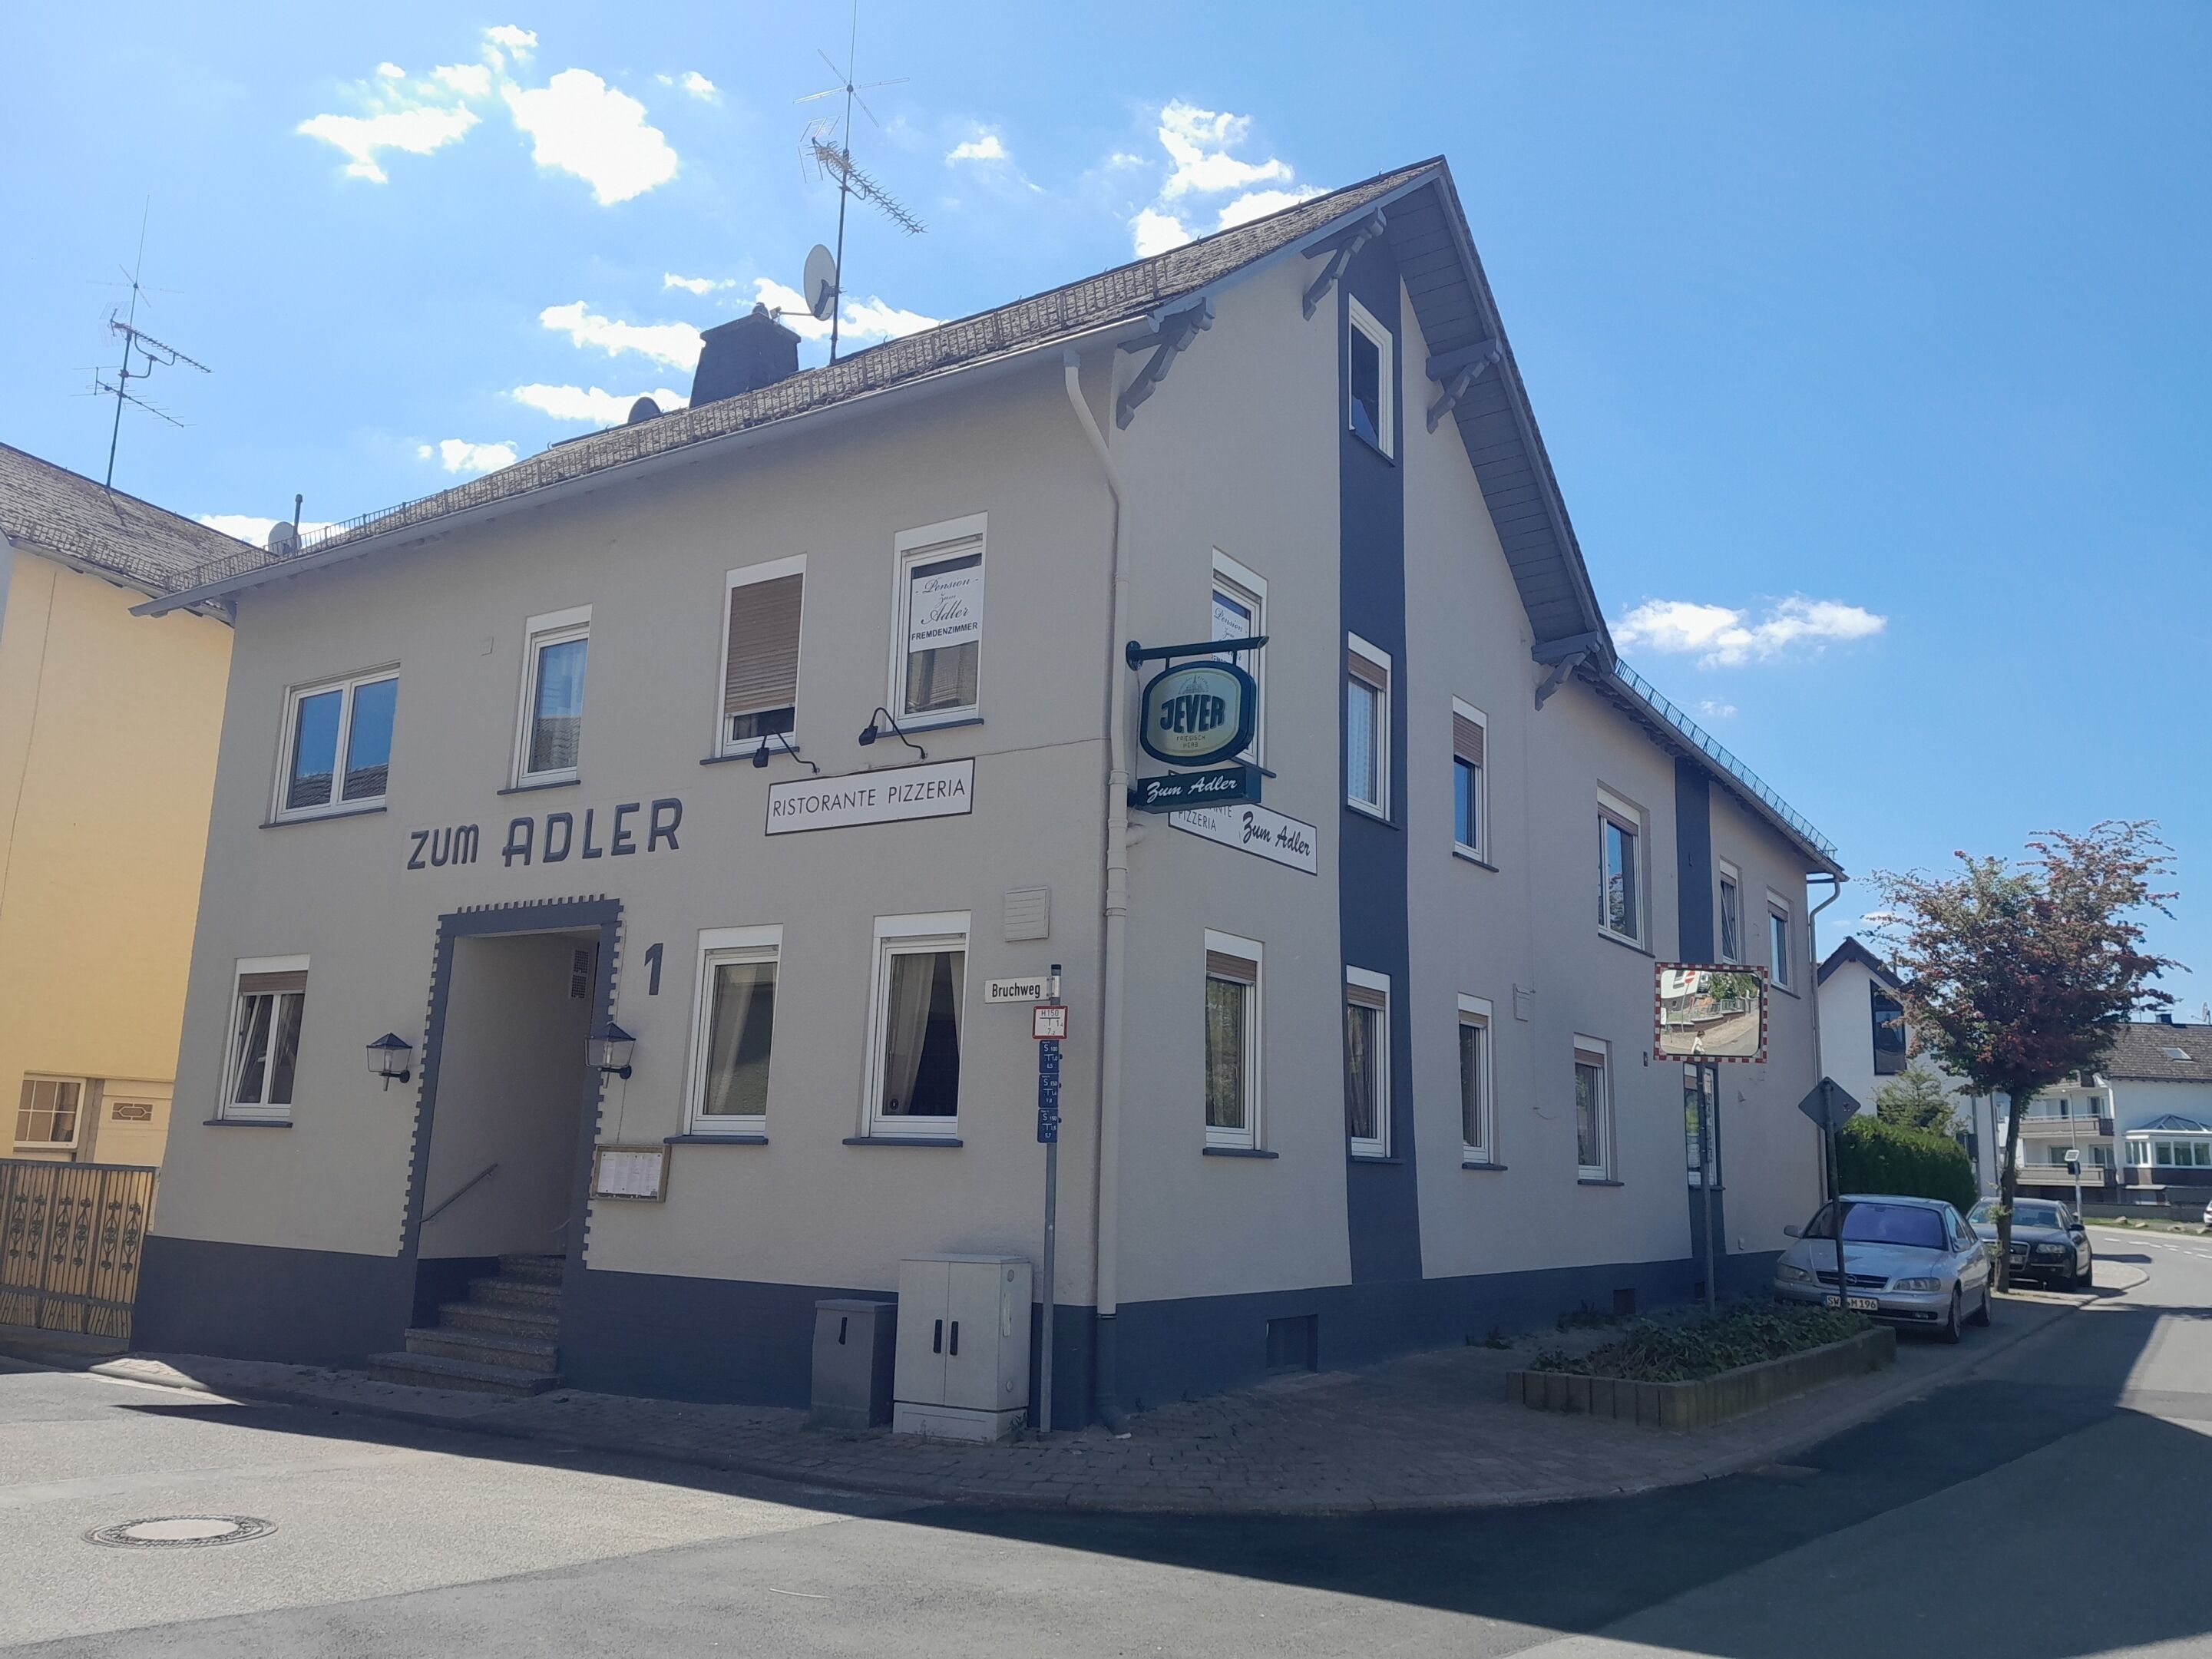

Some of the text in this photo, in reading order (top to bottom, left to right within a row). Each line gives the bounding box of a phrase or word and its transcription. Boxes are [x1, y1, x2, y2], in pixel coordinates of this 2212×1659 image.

[922, 577, 970, 593] Pension
[921, 600, 969, 625] Adler
[1213, 607, 1243, 632] Pension
[911, 622, 978, 641] FREMDENZIMMER
[1160, 694, 1225, 733] JEVER
[773, 778, 965, 817] RISTORANTE PIZZERIA
[1146, 775, 1238, 804] Zum Adler
[501, 798, 683, 868] ADLER
[1178, 810, 1217, 832] PIZZERIA
[1242, 811, 1271, 844] Zum
[1275, 825, 1311, 857] Adler
[644, 943, 663, 996] 1
[992, 983, 1040, 998] Bruchweg
